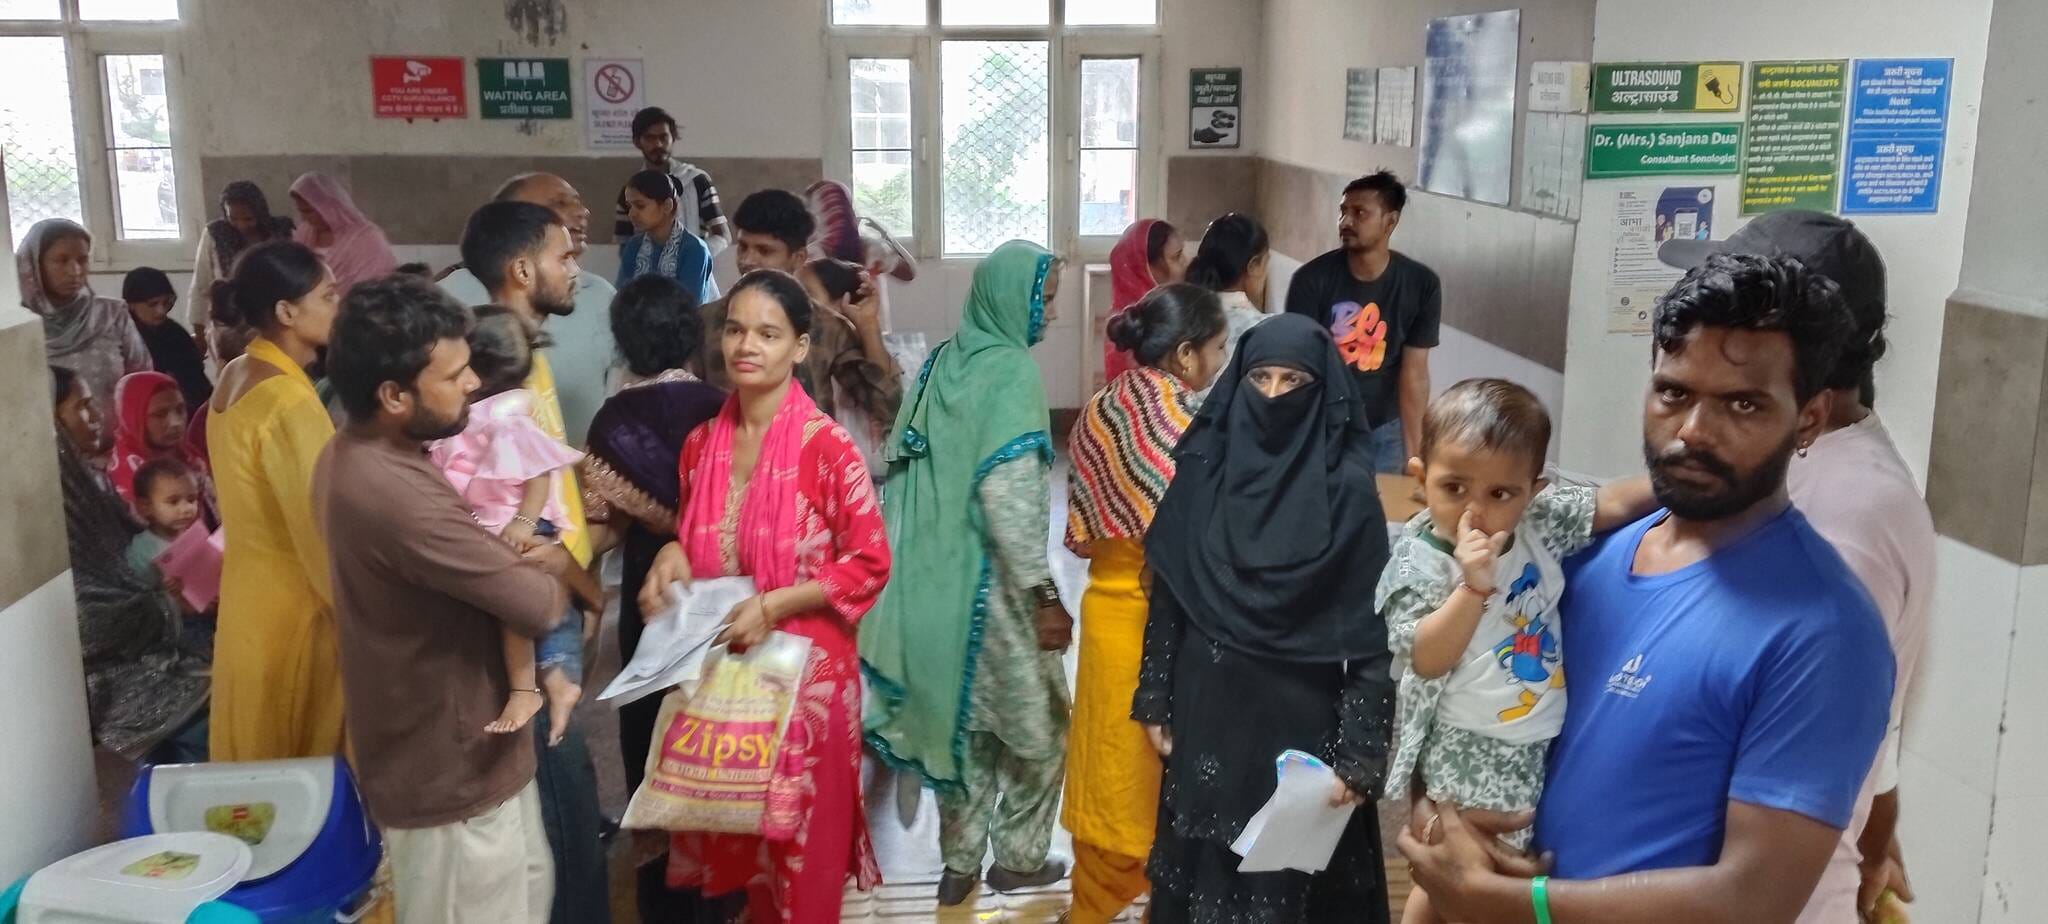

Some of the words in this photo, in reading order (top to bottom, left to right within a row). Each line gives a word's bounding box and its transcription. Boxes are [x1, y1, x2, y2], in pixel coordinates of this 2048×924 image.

[1611, 69, 1682, 86] ULTRASOUND
[1790, 78, 1840, 88] DOCUMENTS
[483, 90, 533, 101] WAITING
[535, 90, 568, 101] AREA
[1611, 86, 1680, 105] अल्ट्रासाउंड
[1594, 134, 1614, 147] Dr.
[1617, 133, 1655, 149] (Mrs.)
[1658, 132, 1708, 148] Sanjana
[1711, 132, 1738, 145] Dua
[1640, 155, 1689, 164] Consultant
[671, 719, 774, 779] Zipsy
